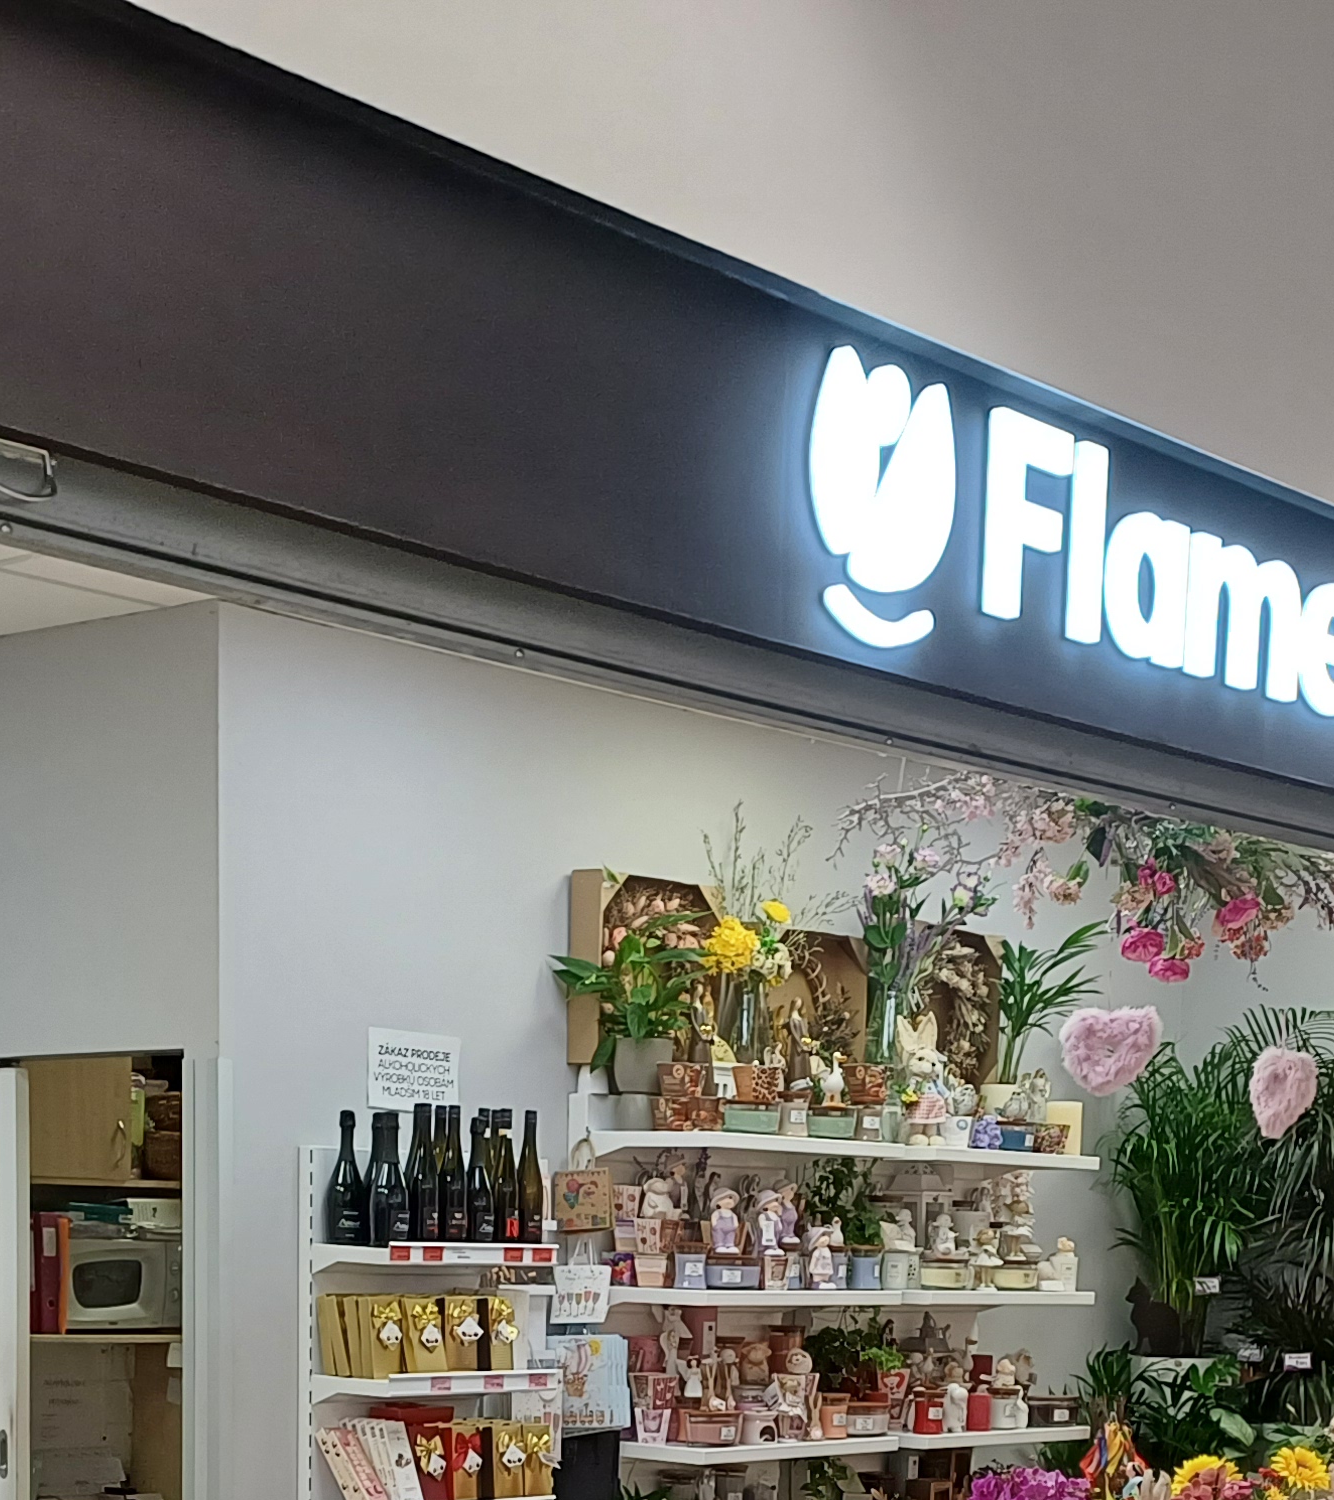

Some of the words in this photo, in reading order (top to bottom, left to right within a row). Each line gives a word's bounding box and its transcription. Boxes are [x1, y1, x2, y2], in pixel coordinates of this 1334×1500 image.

[378, 1042, 409, 1058] ZÁKAZ
[411, 1048, 451, 1062] PRODEJE
[431, 1091, 445, 1101] LET
